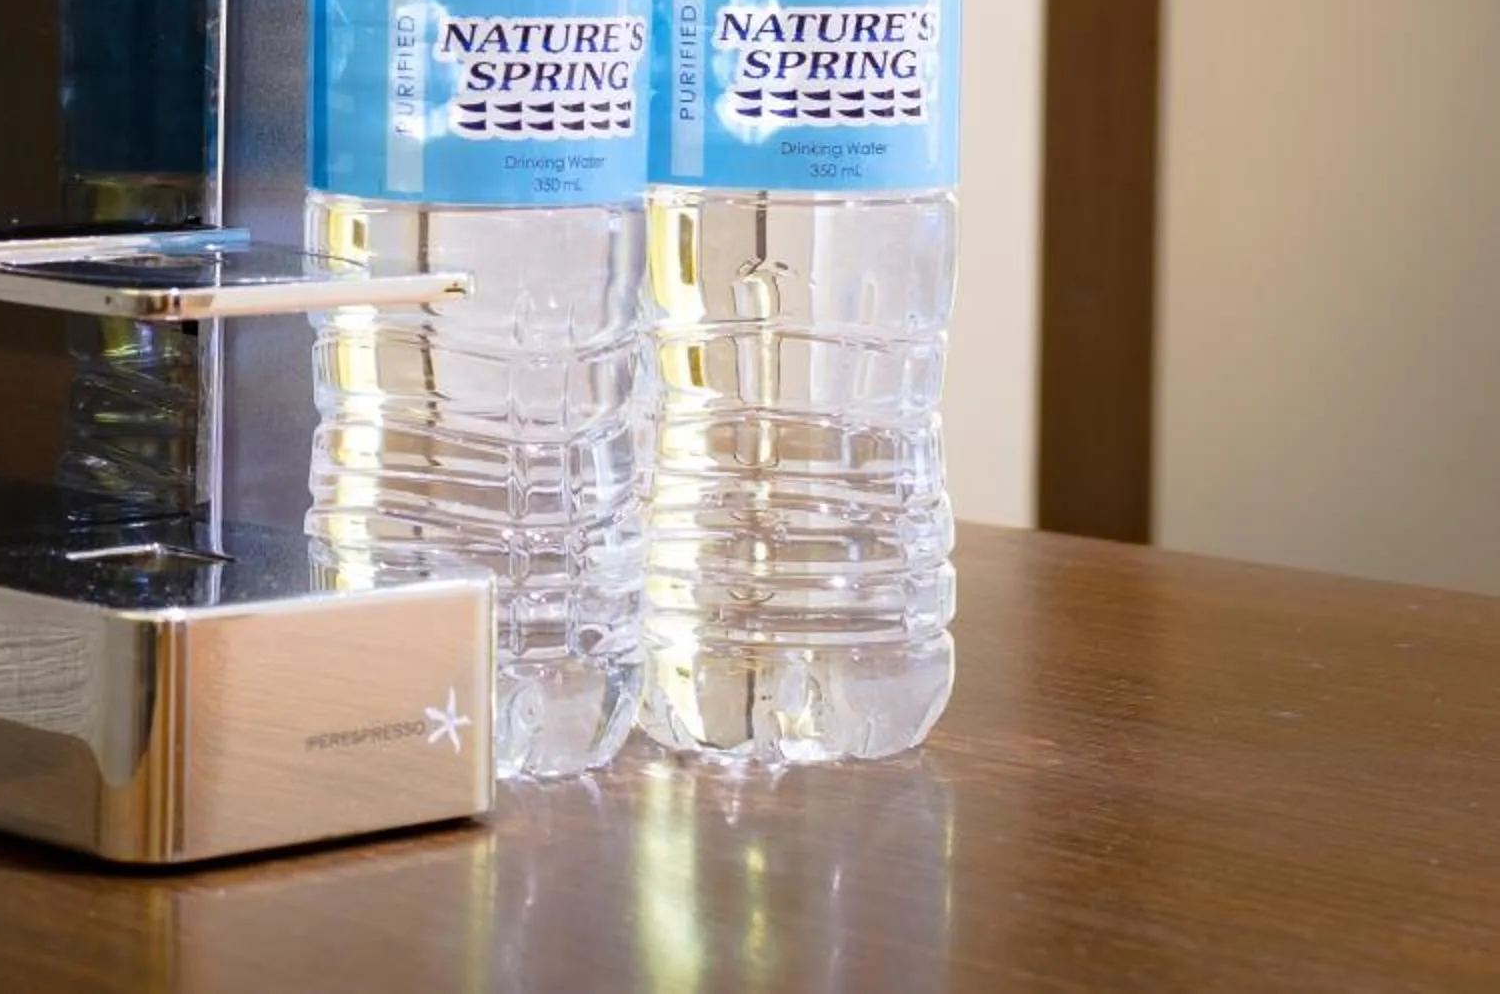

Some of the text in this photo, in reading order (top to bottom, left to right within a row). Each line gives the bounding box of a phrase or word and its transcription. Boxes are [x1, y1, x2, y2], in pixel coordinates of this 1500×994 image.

[441, 21, 644, 55] NATURE'S
[719, 11, 936, 43] NATURE'S
[466, 61, 630, 92] SPRING
[680, 5, 698, 121] PURIFIED
[743, 50, 918, 80] SPRING
[504, 155, 605, 172] Drinking Water
[781, 141, 888, 158] Drinking Water
[533, 178, 561, 192] 350
[809, 163, 837, 177] 350
